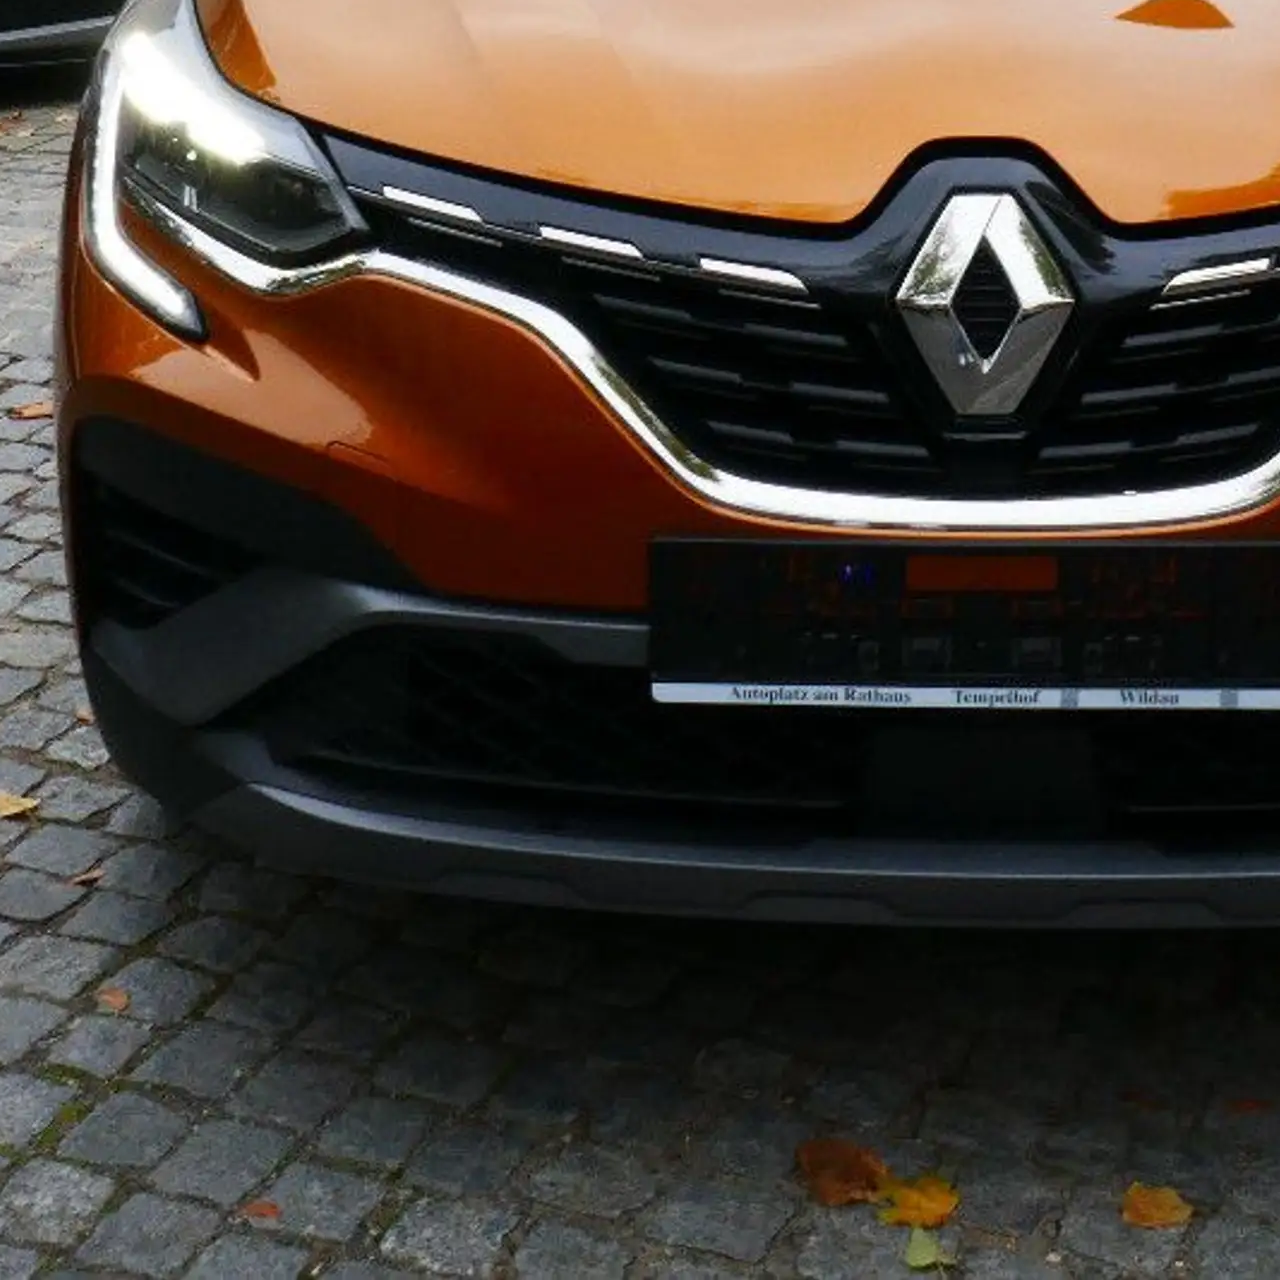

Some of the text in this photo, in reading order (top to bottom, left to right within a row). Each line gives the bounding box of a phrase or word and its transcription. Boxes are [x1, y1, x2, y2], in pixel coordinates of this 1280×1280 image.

[729, 686, 1180, 707] Autoplatz am Rathaus Tempelhof Wildau
